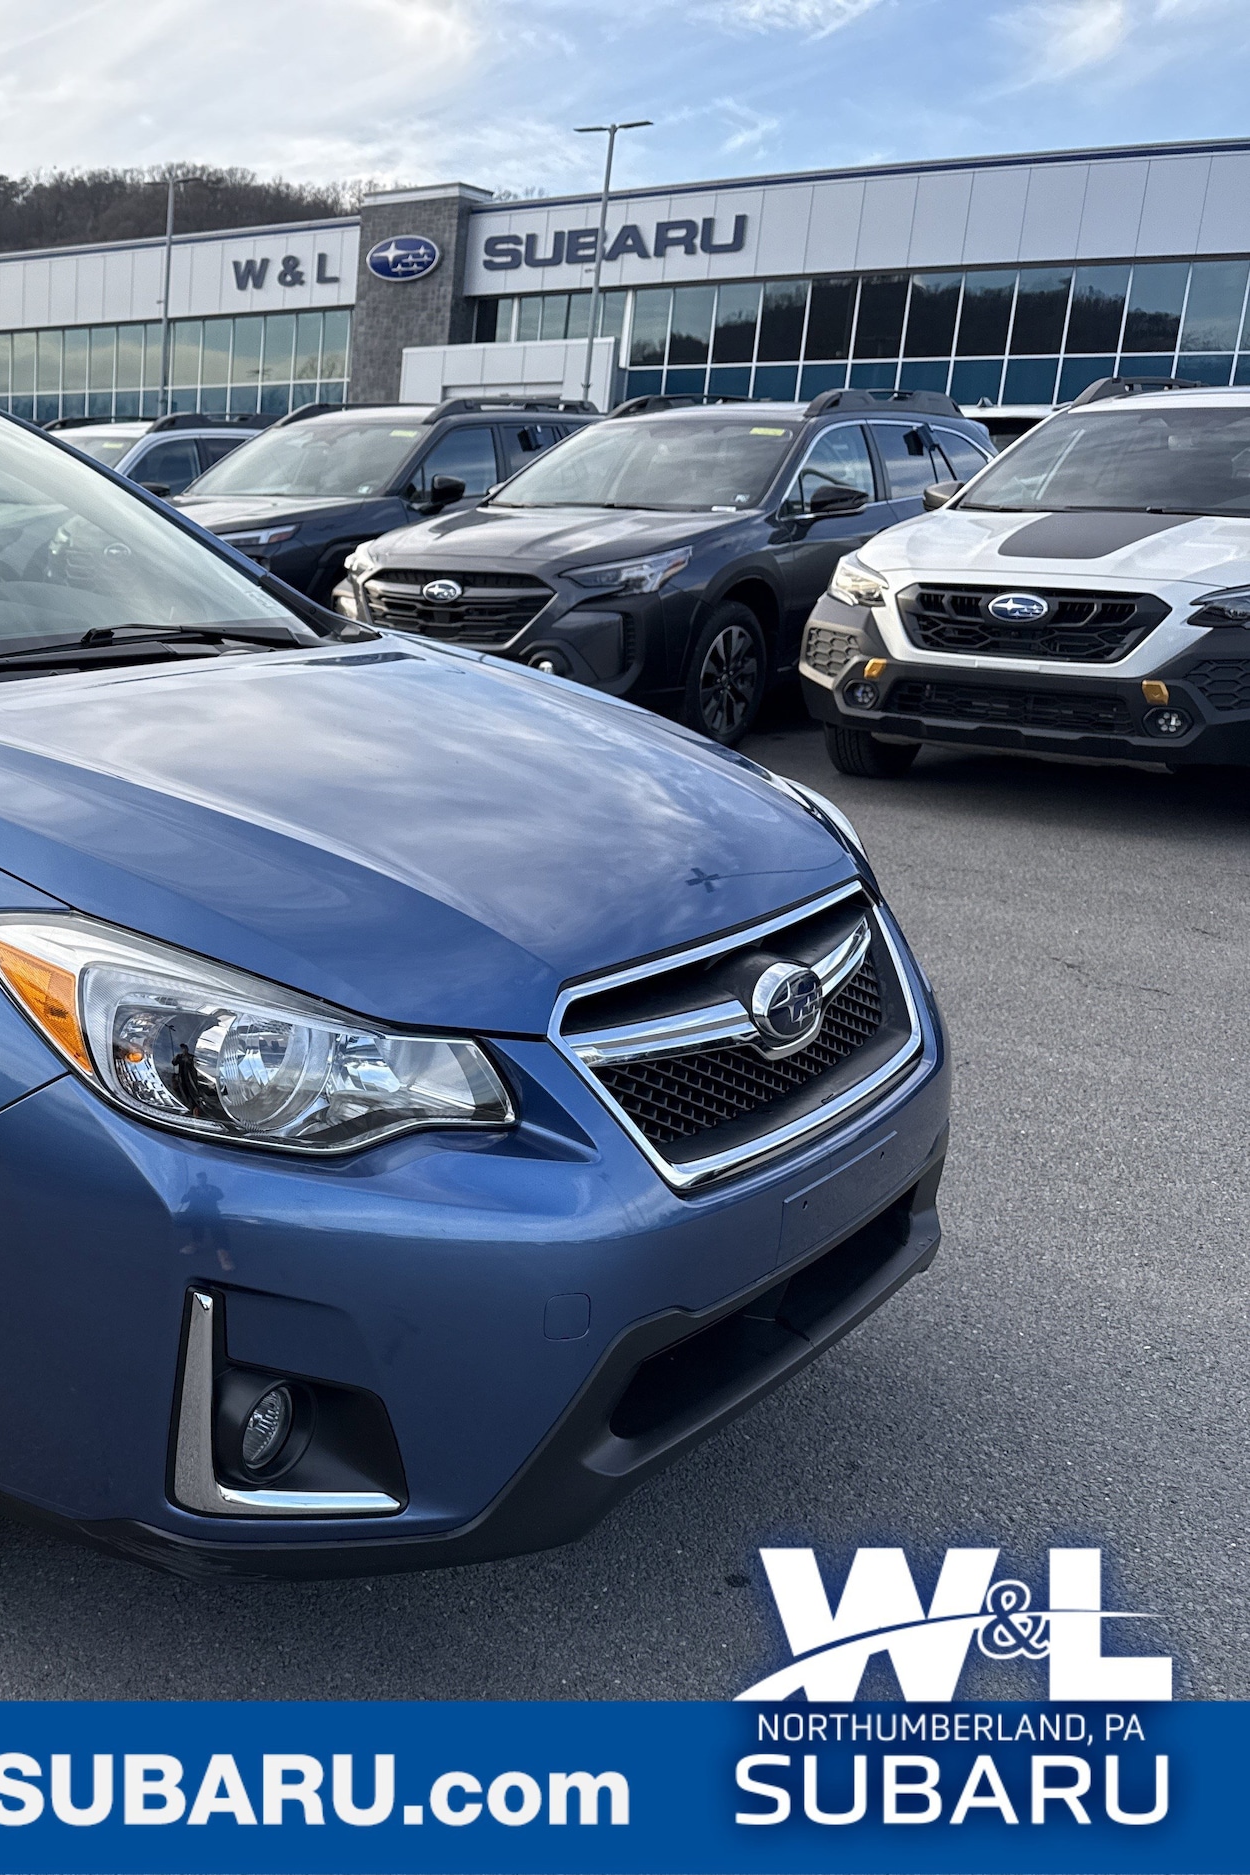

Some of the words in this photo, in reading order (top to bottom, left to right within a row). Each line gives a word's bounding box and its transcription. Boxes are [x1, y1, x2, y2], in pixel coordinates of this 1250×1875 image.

[483, 214, 749, 271] SUBARU
[232, 257, 270, 291] W
[277, 255, 305, 287] &
[316, 252, 340, 284] L
